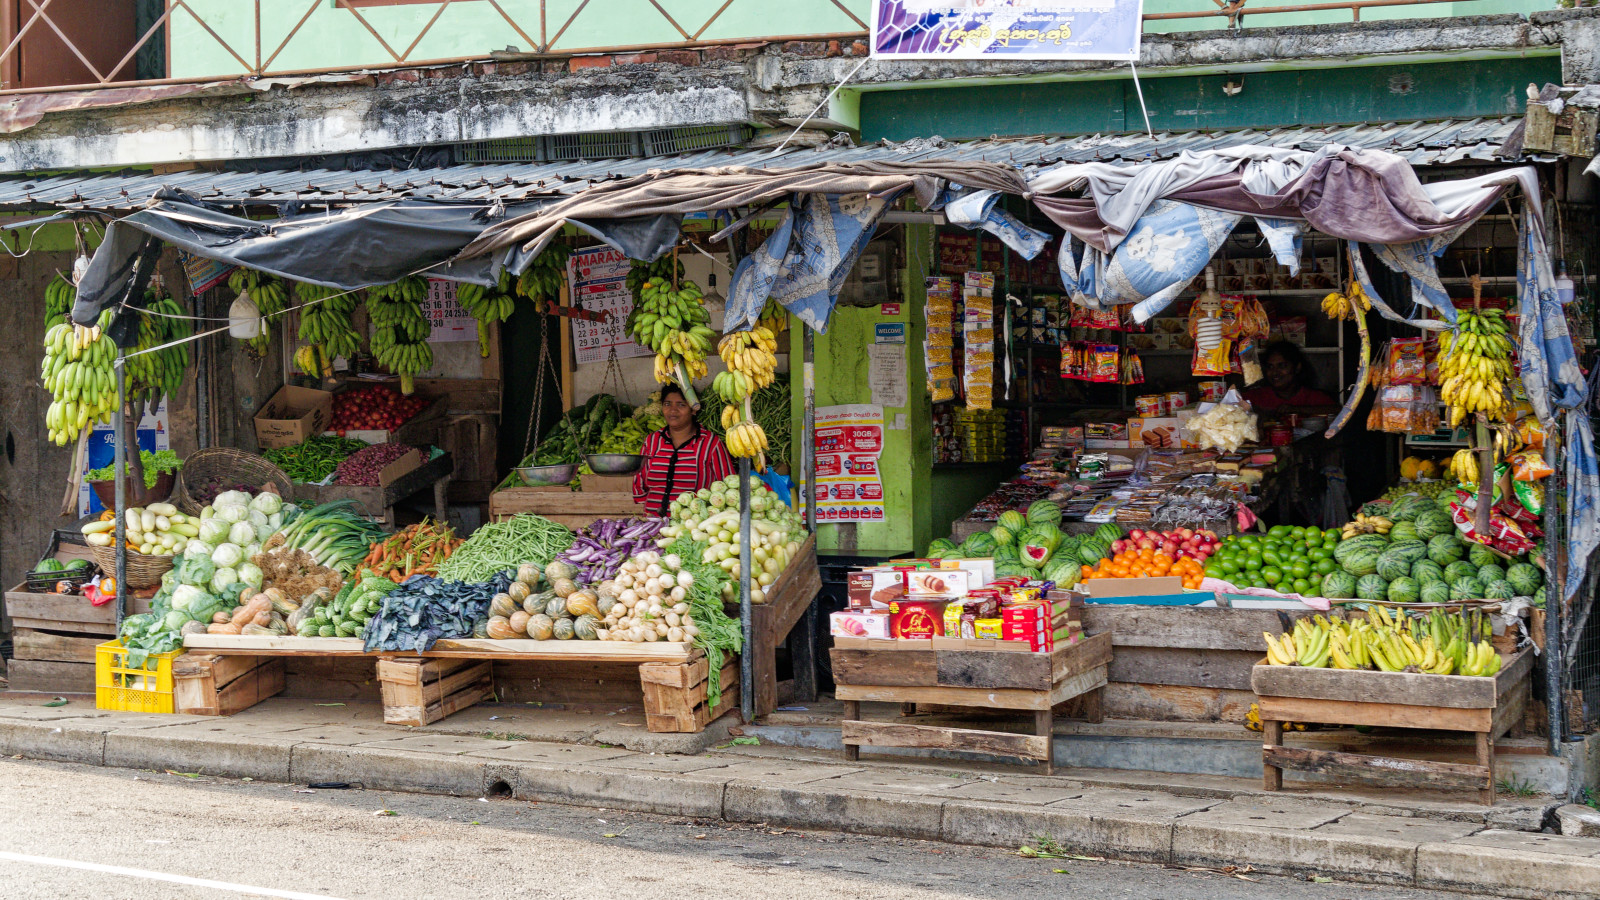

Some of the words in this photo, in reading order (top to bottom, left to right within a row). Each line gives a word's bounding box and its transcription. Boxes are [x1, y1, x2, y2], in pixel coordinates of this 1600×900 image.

[445, 282, 450, 290] 3
[433, 301, 442, 309] 16
[599, 300, 603, 308] 3
[433, 310, 442, 318] 23
[579, 339, 587, 347] 29
